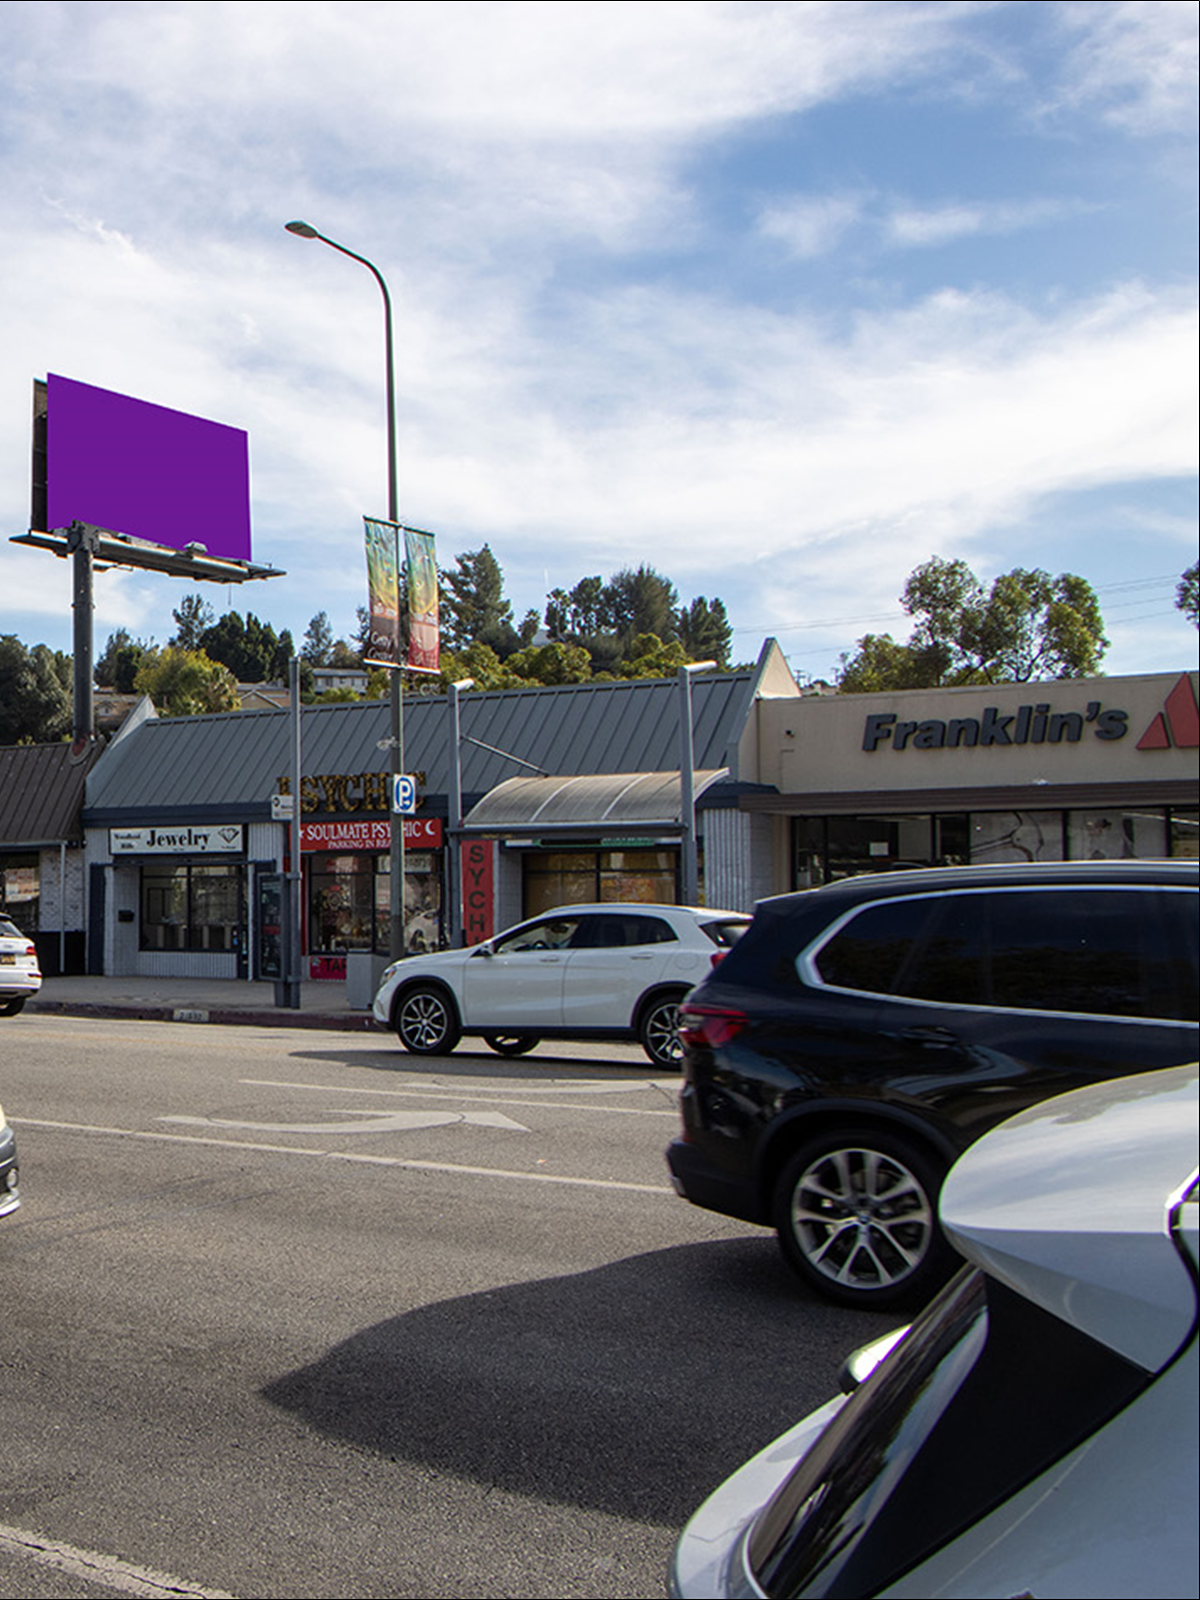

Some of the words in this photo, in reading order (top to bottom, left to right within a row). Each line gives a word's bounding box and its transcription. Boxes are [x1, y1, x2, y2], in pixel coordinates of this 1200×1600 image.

[862, 701, 1129, 751] Franklin's
[146, 829, 210, 850] Jewelry
[307, 823, 369, 841] SOULMATE
[371, 821, 422, 839] PSYHIC
[328, 840, 365, 849] PARKING
[365, 840, 375, 848] IN
[375, 839, 392, 848] REA
